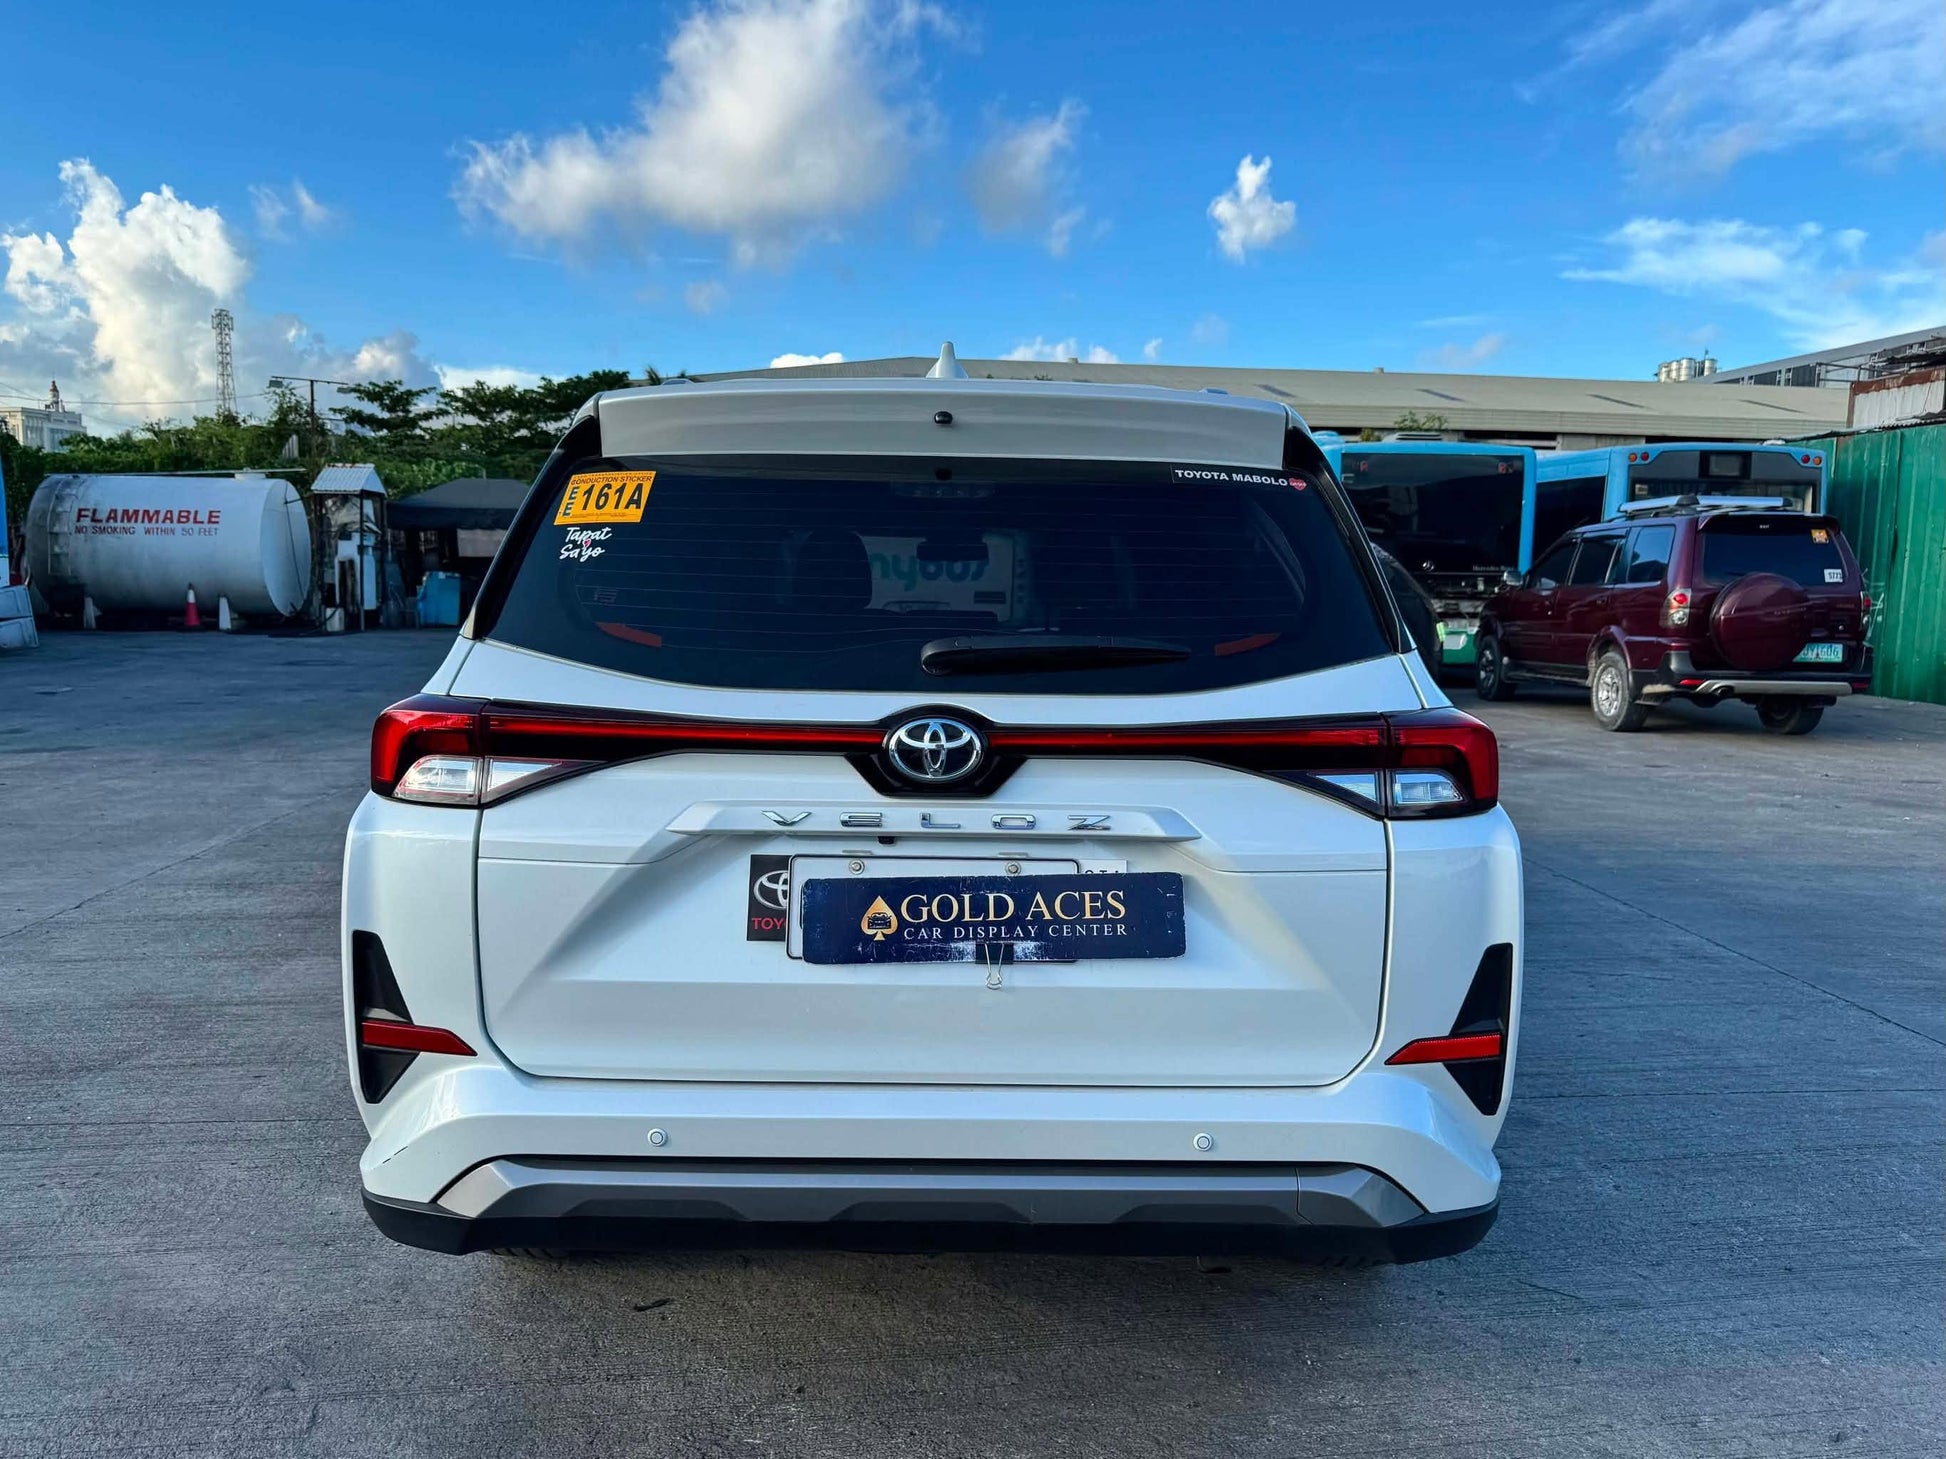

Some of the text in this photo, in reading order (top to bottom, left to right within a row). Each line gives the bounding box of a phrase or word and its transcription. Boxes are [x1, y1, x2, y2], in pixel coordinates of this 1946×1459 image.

[571, 476, 618, 485] CONDUCTION
[620, 475, 652, 483] STICKER
[1175, 469, 1229, 481] TOYOTA
[1232, 473, 1288, 486] MABOLO
[582, 483, 643, 510] 161A
[76, 507, 221, 525] FLAMMABLE
[75, 526, 218, 537] NO SMOKING WITHIN 50 FEET
[565, 526, 612, 545] Tapat
[760, 809, 1112, 831] VELOZ
[900, 889, 1127, 923] GOLD ACES
[752, 916, 787, 931] TOY
[904, 923, 1128, 940] CAR DISPLAY CENTER
